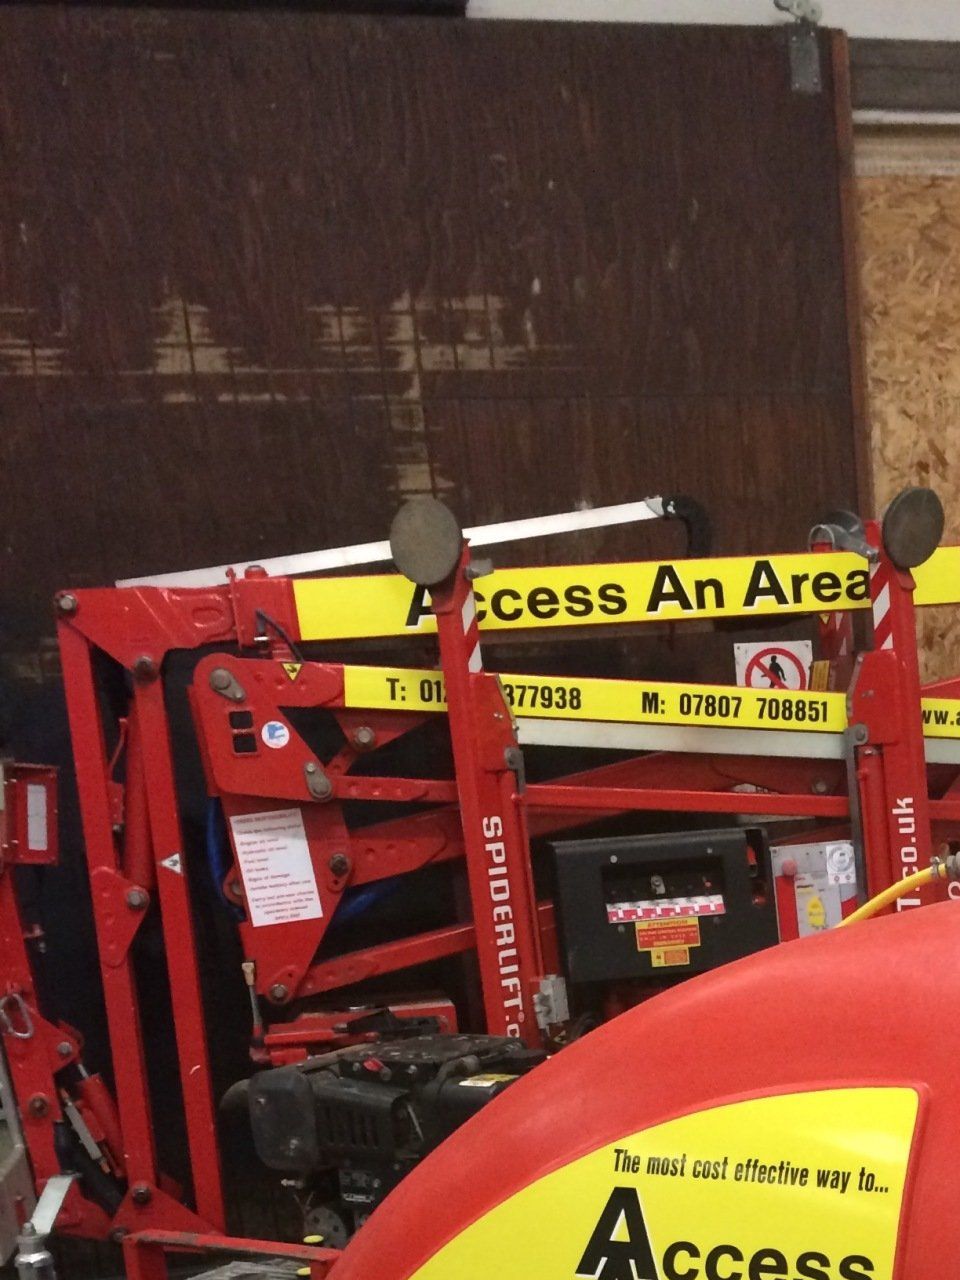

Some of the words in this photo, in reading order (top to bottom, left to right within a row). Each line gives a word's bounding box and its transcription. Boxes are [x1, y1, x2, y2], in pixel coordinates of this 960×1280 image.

[646, 564, 726, 613] An
[742, 560, 869, 609] Area
[386, 677, 407, 702] T:
[641, 691, 666, 715] M:
[679, 693, 742, 718] 07807
[756, 697, 828, 722] 708851
[613, 1148, 640, 1174] The
[646, 1153, 686, 1178] most
[692, 1155, 728, 1181] cost
[734, 1158, 809, 1187] effective
[816, 1168, 851, 1194] way
[858, 1166, 890, 1194] to...
